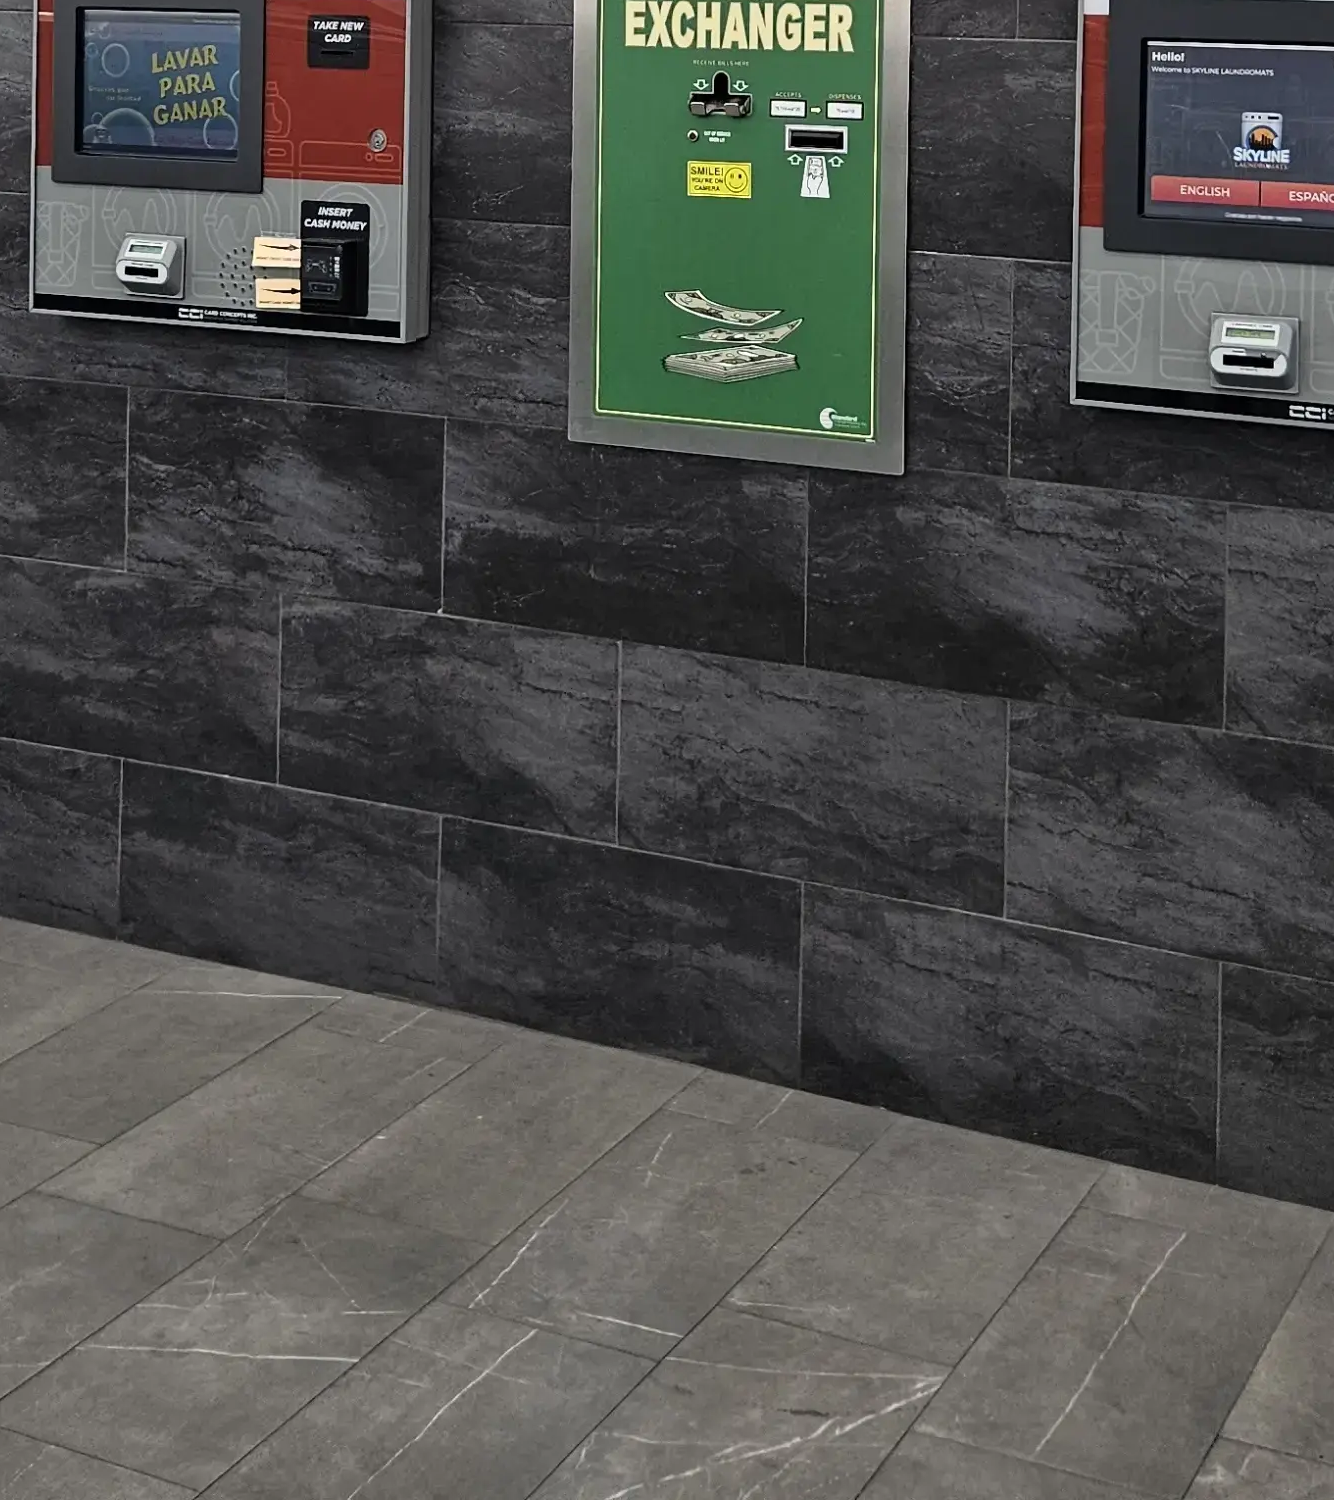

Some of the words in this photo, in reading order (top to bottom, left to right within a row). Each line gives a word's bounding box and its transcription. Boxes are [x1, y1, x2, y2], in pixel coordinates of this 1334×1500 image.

[313, 21, 339, 31] TAKE
[341, 22, 364, 31] NEW
[623, 0, 854, 53] EXCHANGER
[324, 33, 352, 43] CARD
[151, 45, 219, 73] LAVAR
[1152, 52, 1185, 62] Hello!
[1192, 67, 1219, 75] SKYLINE
[159, 72, 215, 98] PARA
[153, 97, 227, 125] GANAR
[1233, 147, 1290, 164] SKYLINE
[691, 167, 724, 176] SMILE!
[1180, 185, 1230, 197] ENGLISH
[317, 207, 353, 218] INSERT
[304, 218, 330, 229] CASH
[332, 219, 367, 231] MONEY
